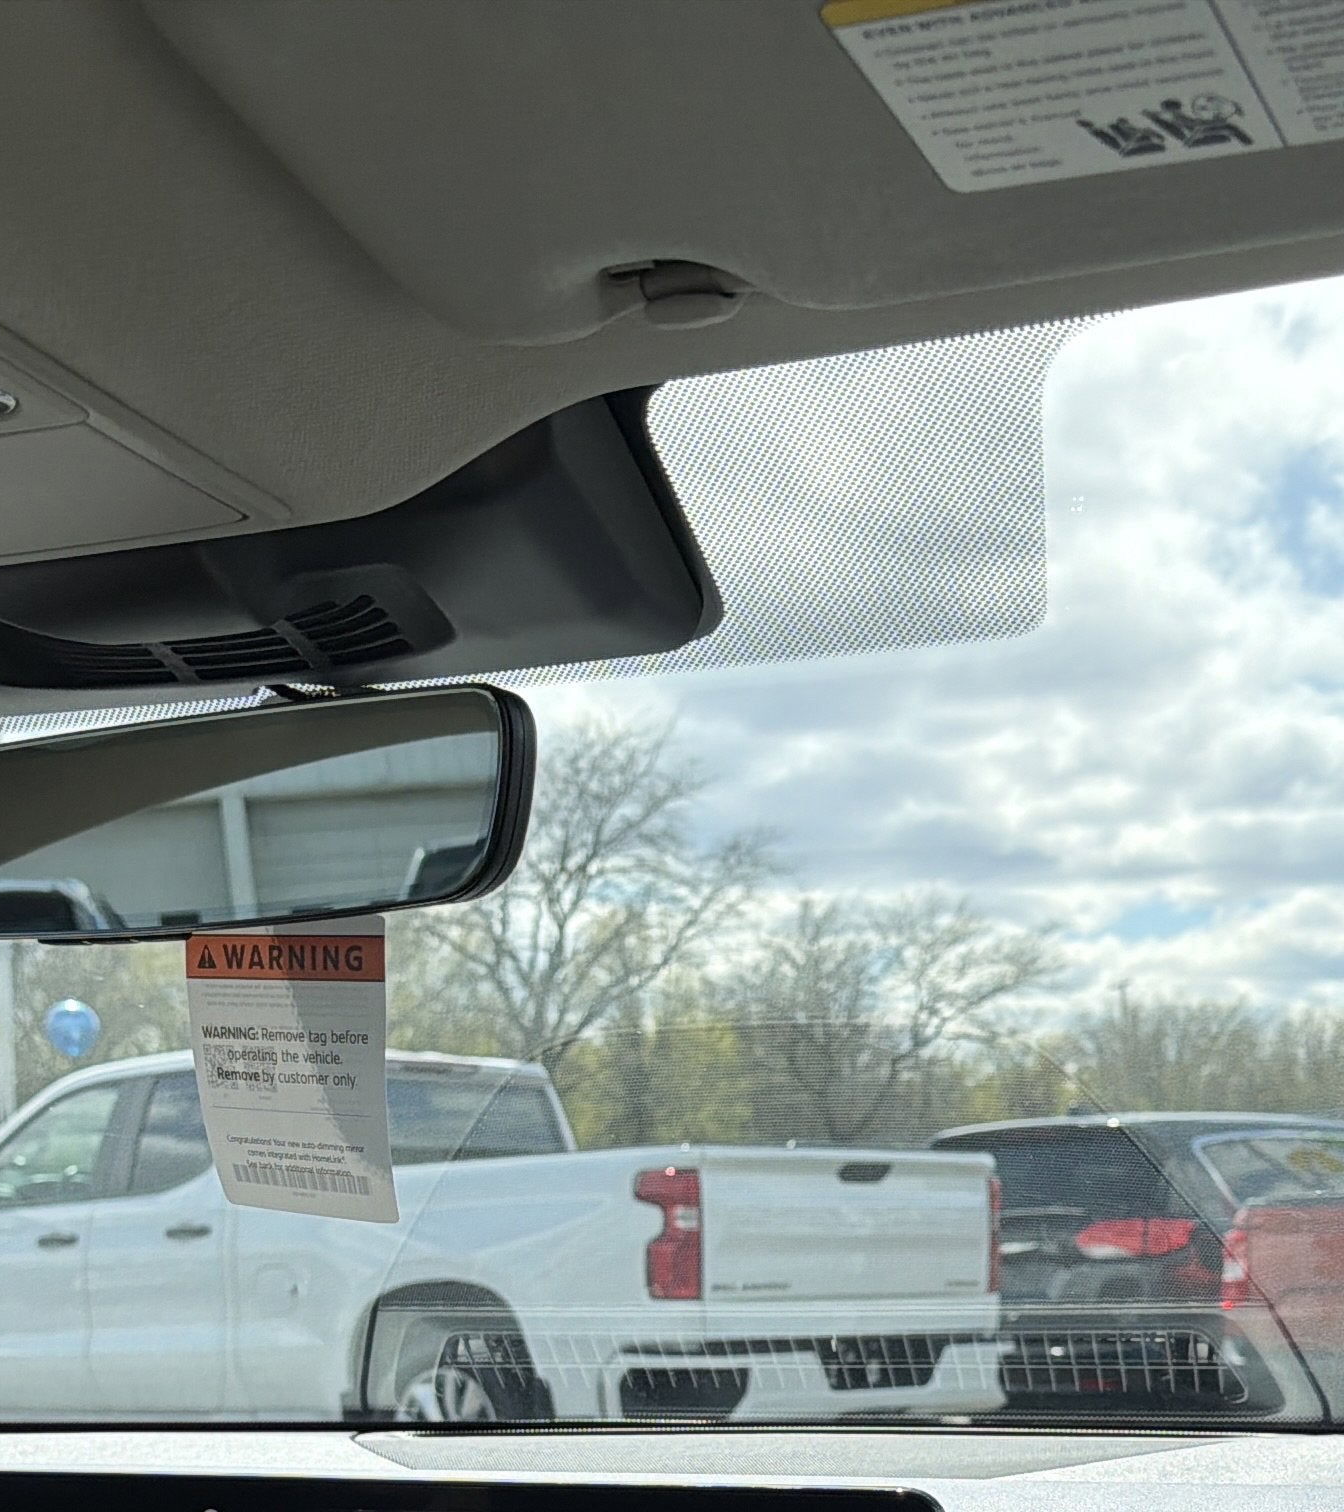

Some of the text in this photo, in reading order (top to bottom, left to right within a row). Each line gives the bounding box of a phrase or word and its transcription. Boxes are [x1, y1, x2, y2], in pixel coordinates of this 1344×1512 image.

[222, 944, 363, 972] WARNING
[201, 1025, 368, 1046] WARNING: Remove tag before
[227, 1049, 343, 1065] operating the vehicle.
[217, 1067, 358, 1090] Remove by customer only.
